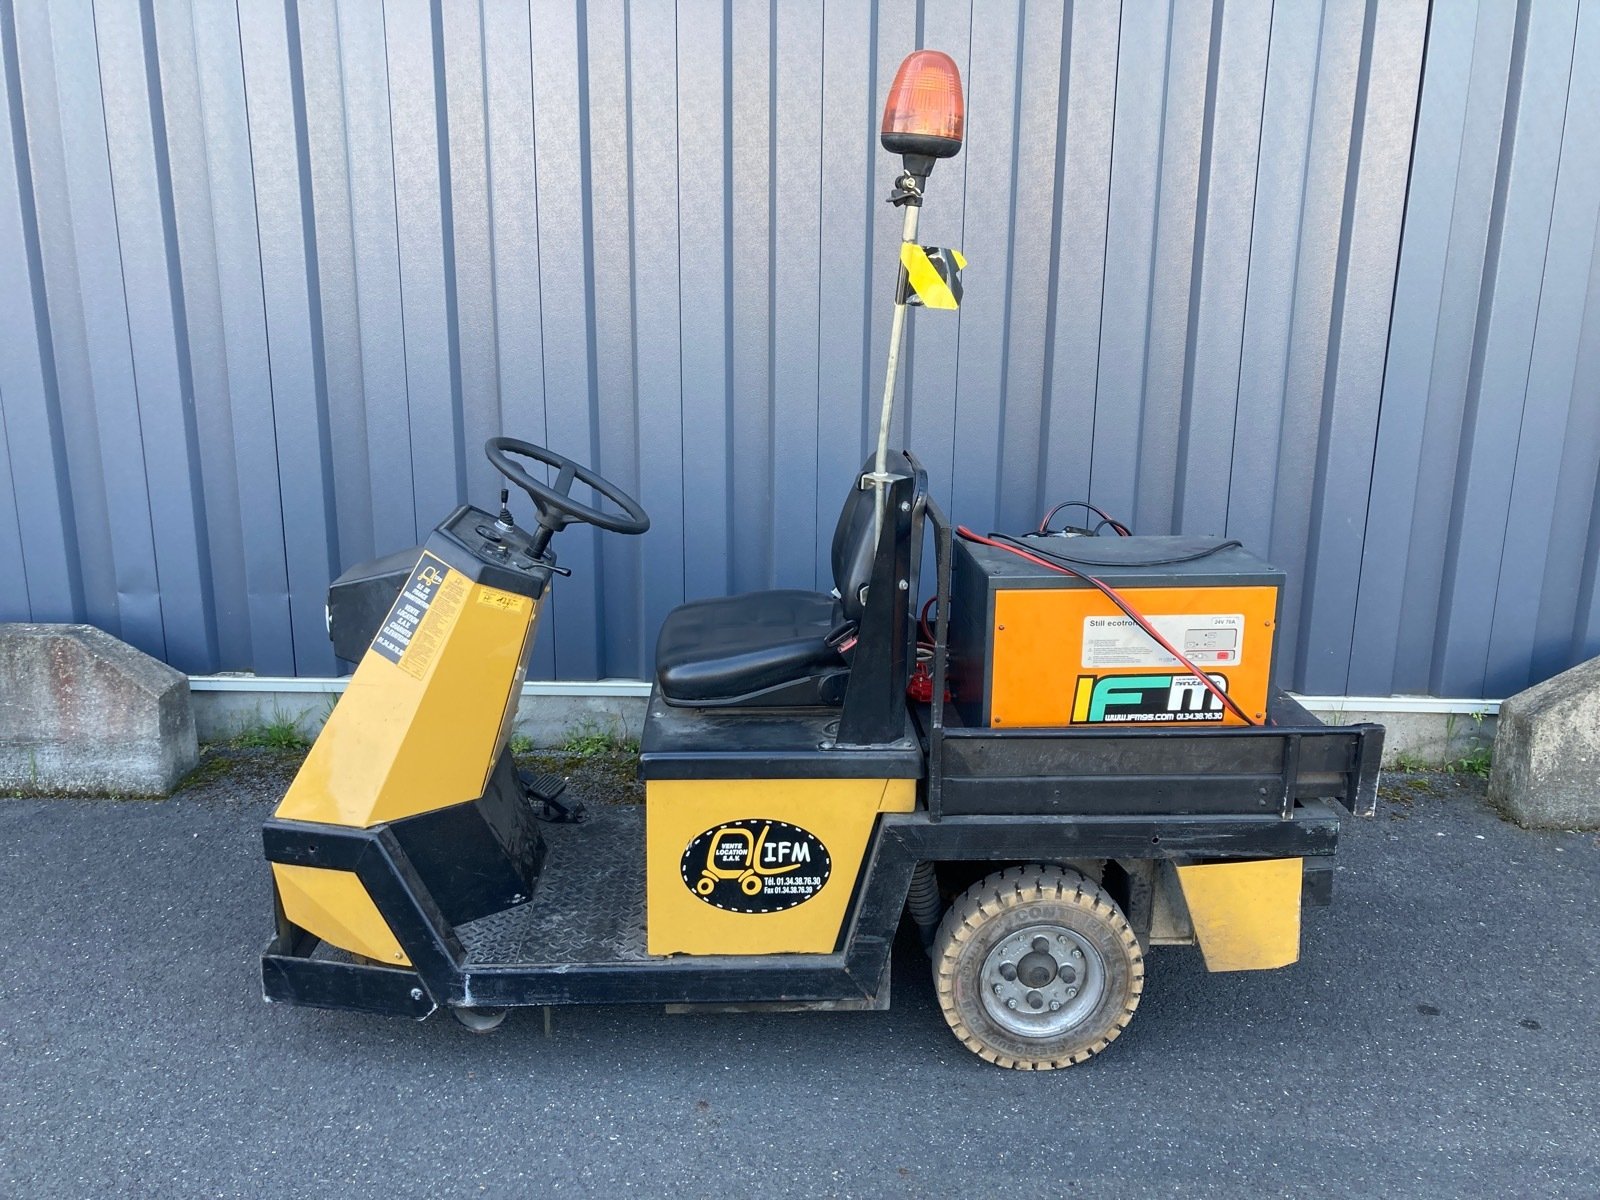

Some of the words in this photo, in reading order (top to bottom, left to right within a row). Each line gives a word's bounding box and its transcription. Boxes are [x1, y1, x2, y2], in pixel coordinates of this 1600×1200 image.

[403, 591, 430, 610] MANUTENTION
[412, 588, 429, 601] FRANCE
[396, 608, 420, 625] LOCATION
[404, 604, 421, 617] VENTE
[390, 621, 413, 638] CHARIOTS
[1089, 619, 1105, 627] Still
[383, 626, 411, 646] ELEVATEURS
[1176, 712, 1223, 720] 01.34.38.76.30
[764, 841, 811, 863] IFM
[776, 876, 821, 885] 01.34.38.76.30
[764, 886, 774, 894] Fax
[774, 886, 813, 894] 01.34.38.76.39
